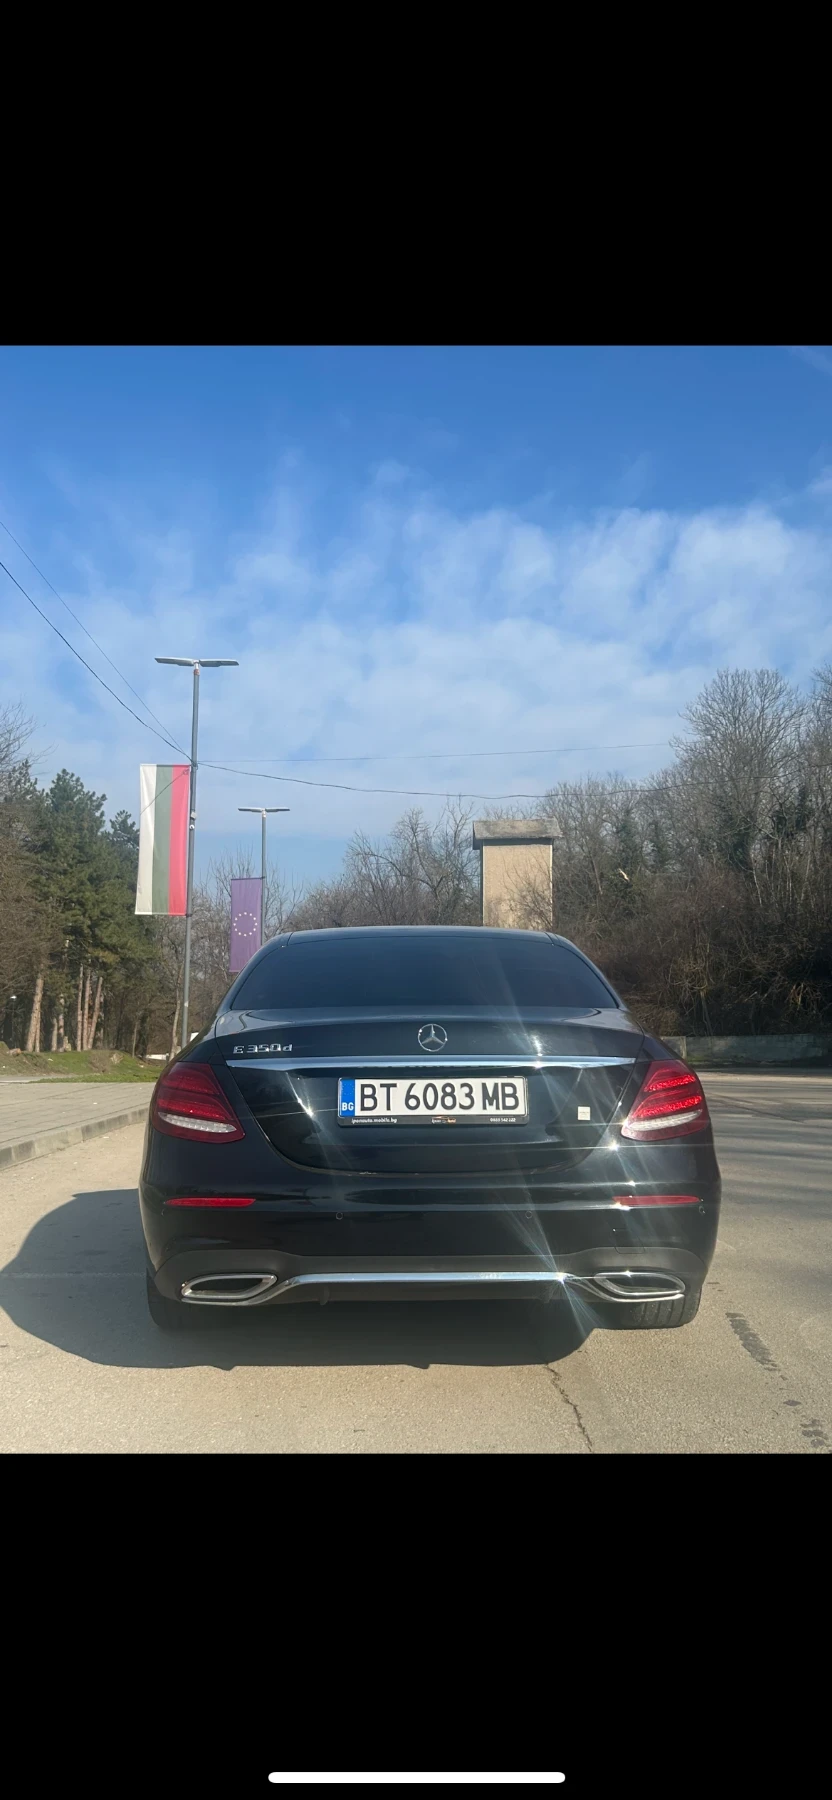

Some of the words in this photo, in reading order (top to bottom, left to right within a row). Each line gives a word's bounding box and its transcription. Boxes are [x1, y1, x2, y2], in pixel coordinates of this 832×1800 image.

[233, 1045, 245, 1054] E
[360, 1083, 398, 1112] BT
[404, 1082, 475, 1111] 6083
[481, 1082, 520, 1111] MB
[341, 1102, 355, 1111] BG
